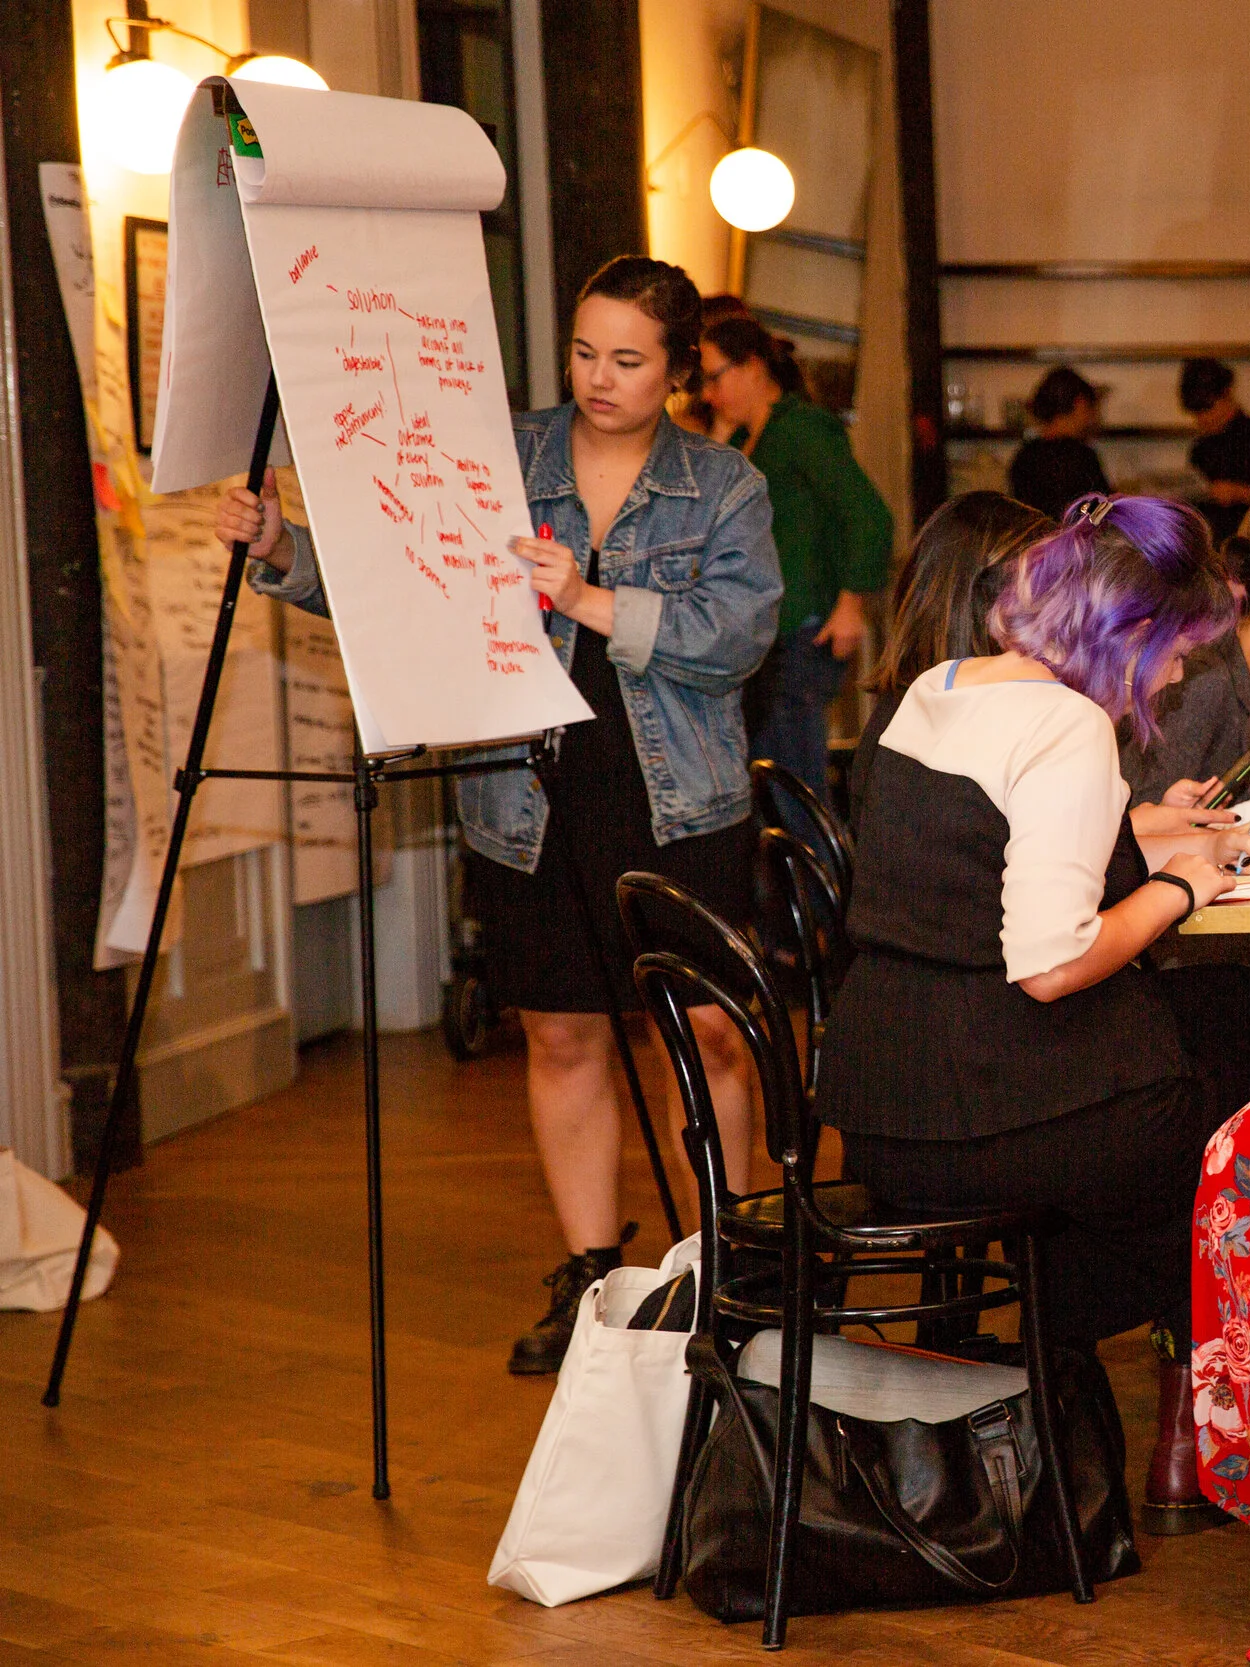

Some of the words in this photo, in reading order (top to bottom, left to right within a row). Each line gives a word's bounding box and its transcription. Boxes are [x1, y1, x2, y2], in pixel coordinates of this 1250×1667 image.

[347, 289, 396, 313] solution
[416, 314, 448, 340] taking
[452, 341, 464, 355] all
[398, 428, 436, 448] outcome
[405, 453, 429, 471] every
[410, 473, 443, 487] solution
